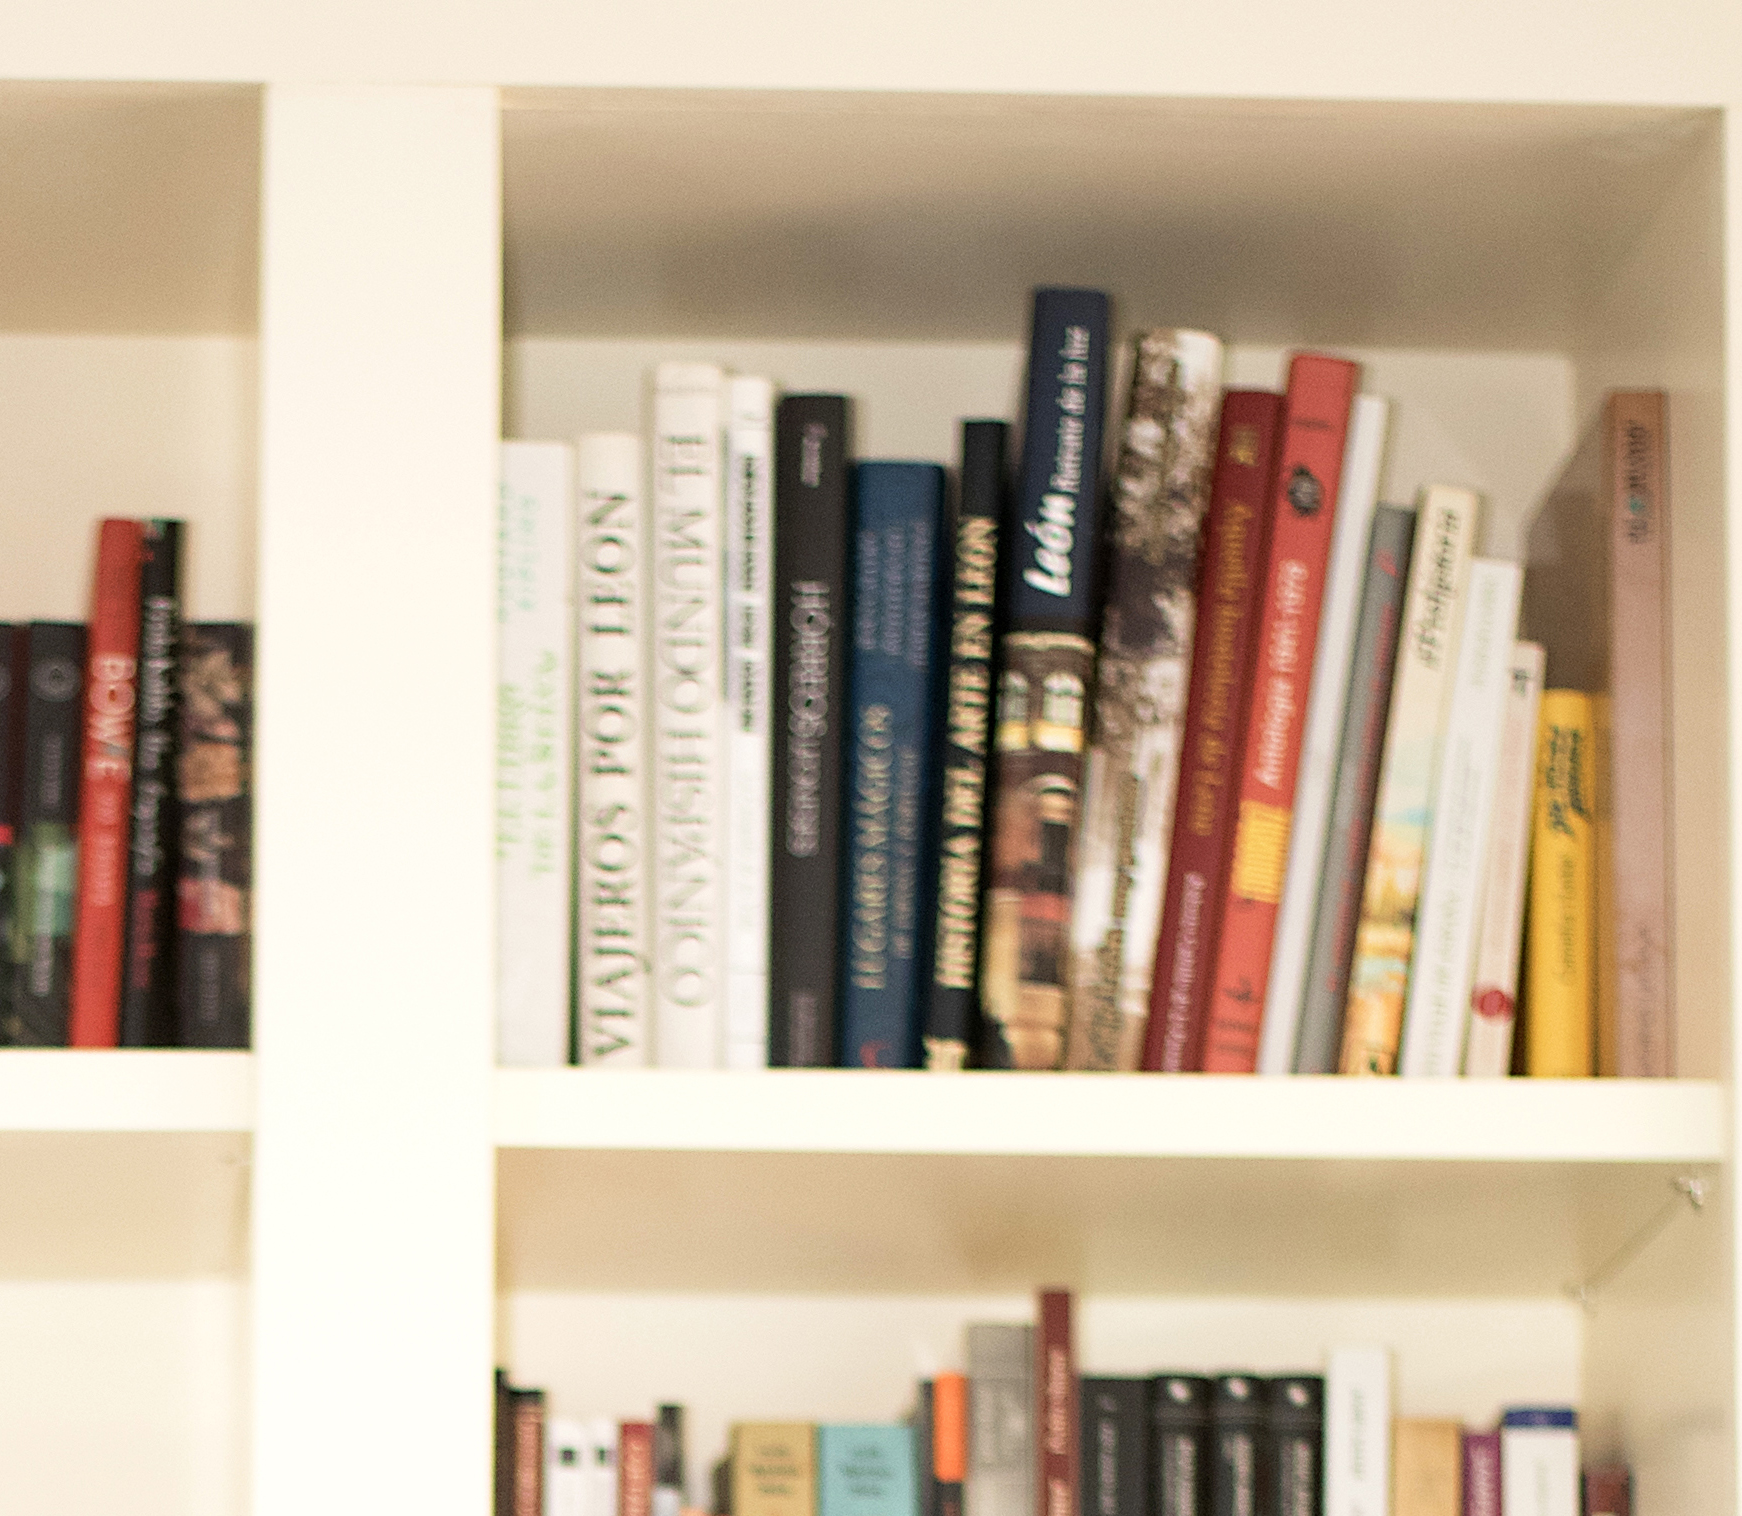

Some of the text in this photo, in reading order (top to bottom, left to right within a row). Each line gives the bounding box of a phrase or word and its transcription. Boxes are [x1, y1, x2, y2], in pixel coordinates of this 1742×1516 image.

[661, 436, 705, 498] EL
[1022, 493, 1077, 598] León
[659, 509, 711, 715] MUNDO
[950, 612, 993, 658] EN
[583, 669, 635, 779] POR
[946, 663, 990, 754] ARTE
[942, 760, 986, 828] DEL
[582, 803, 651, 1058] VIAJEROS
[933, 834, 977, 989] HISTORIA
